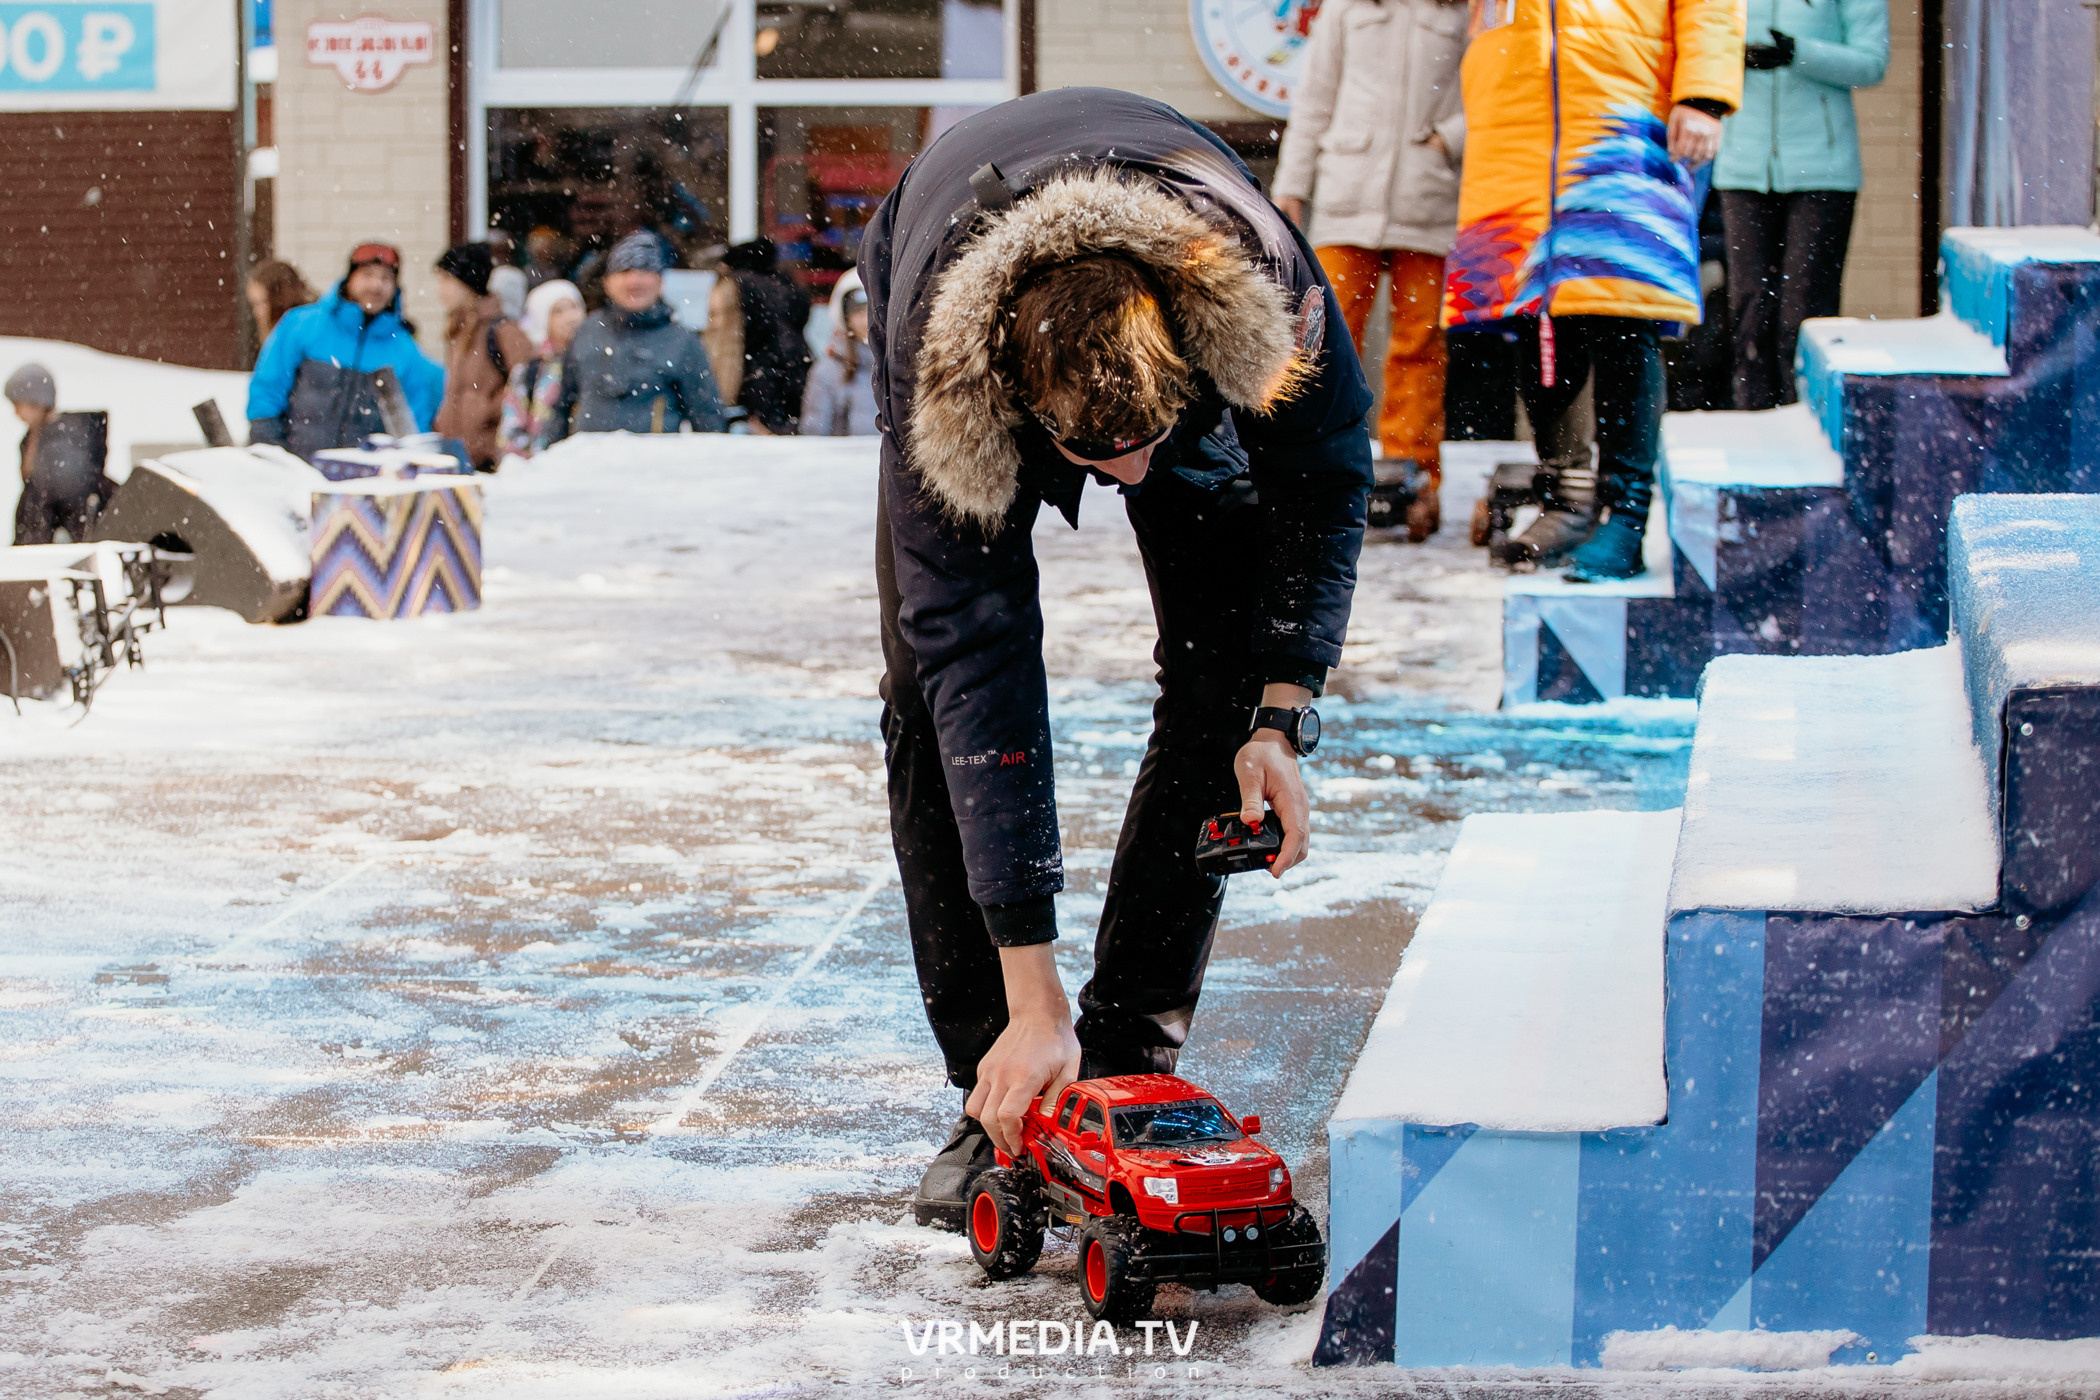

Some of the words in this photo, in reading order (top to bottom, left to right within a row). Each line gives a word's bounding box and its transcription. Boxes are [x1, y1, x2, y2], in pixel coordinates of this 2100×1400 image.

[0, 11, 66, 82] 0
[1000, 751, 1026, 767] AIR
[1130, 1104, 1154, 1112] NEW
[1160, 1099, 1200, 1110] BRIGHT
